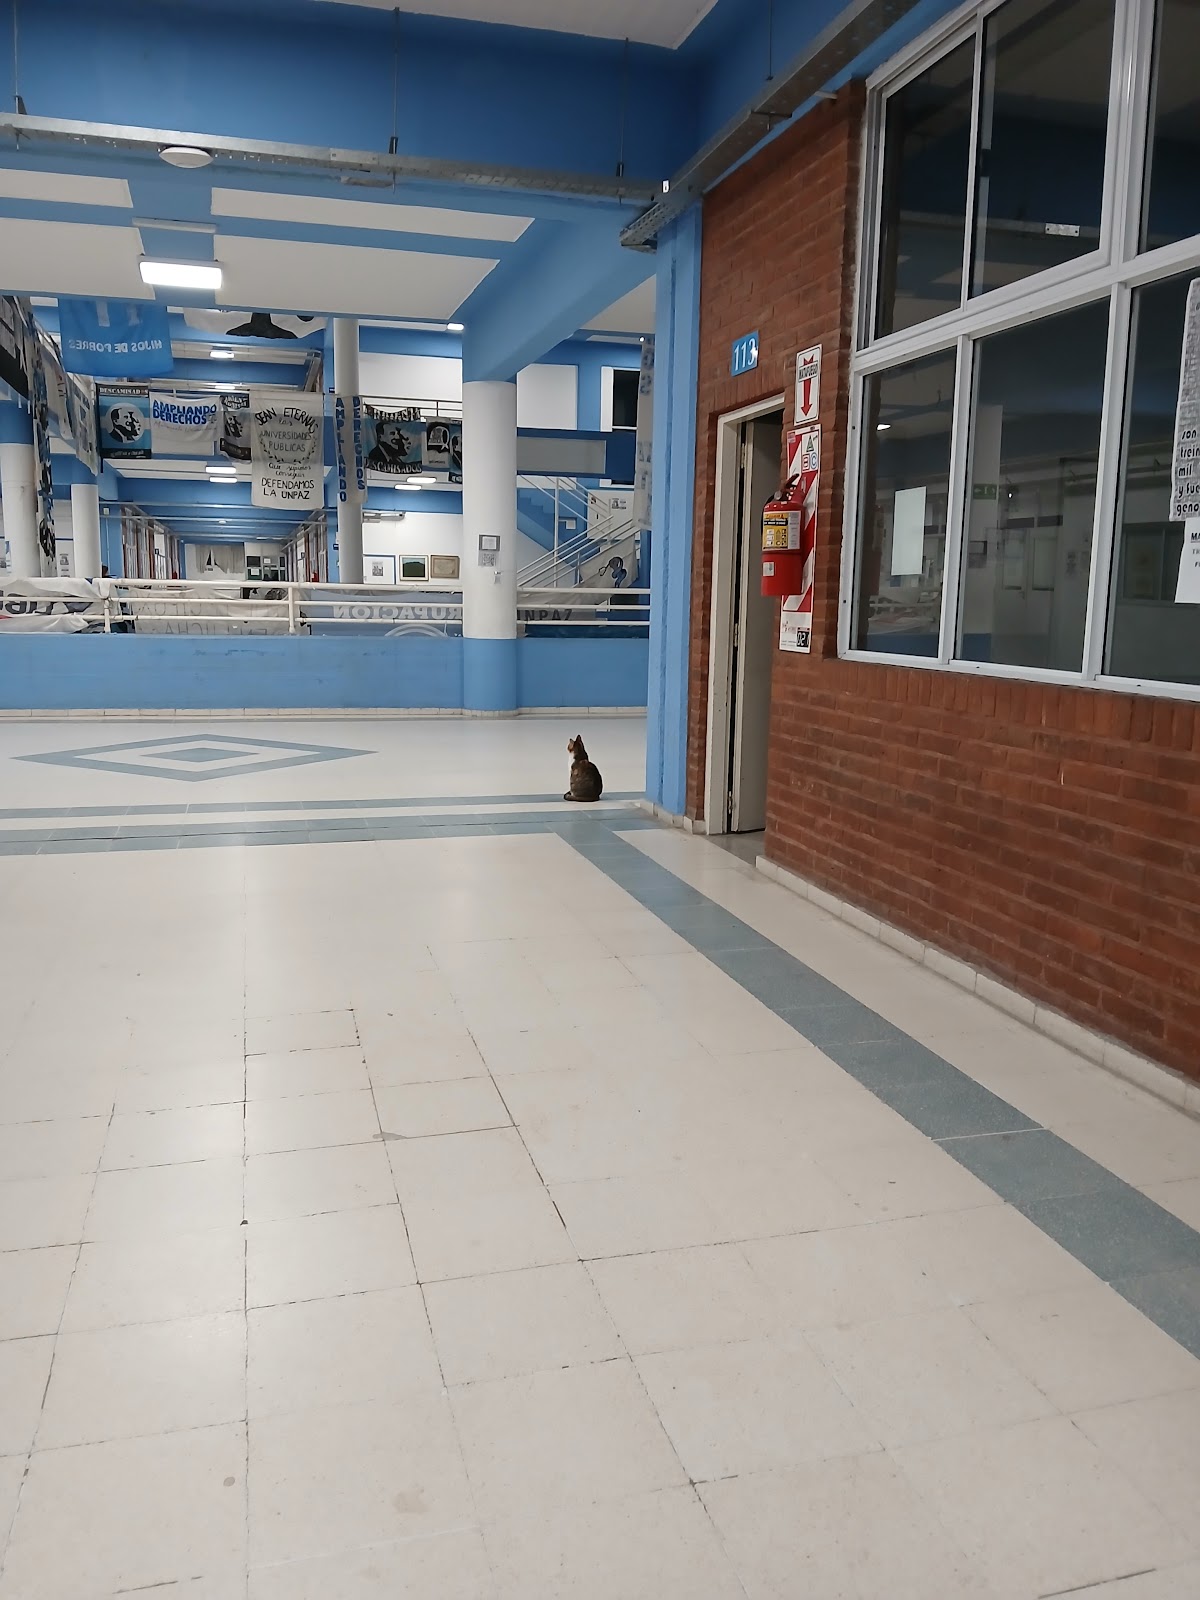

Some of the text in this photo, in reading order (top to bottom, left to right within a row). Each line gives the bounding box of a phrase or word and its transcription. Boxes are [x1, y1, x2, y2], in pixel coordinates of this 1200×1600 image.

[734, 338, 758, 371] 113
[152, 399, 217, 415] AMPLIANDO
[152, 408, 207, 425] DERECHOS
[254, 407, 319, 434] SEAN ETERNAS
[260, 430, 312, 441] UNIVERSIDADES
[1181, 429, 1197, 440] son
[268, 440, 306, 452] PUBLICAS
[335, 397, 347, 502] AMPLIANDO
[352, 395, 366, 490] DERECHOS
[1178, 463, 1192, 477] mil
[261, 477, 315, 490] DEFENDAMOS
[263, 487, 310, 500] LA UNPAZ
